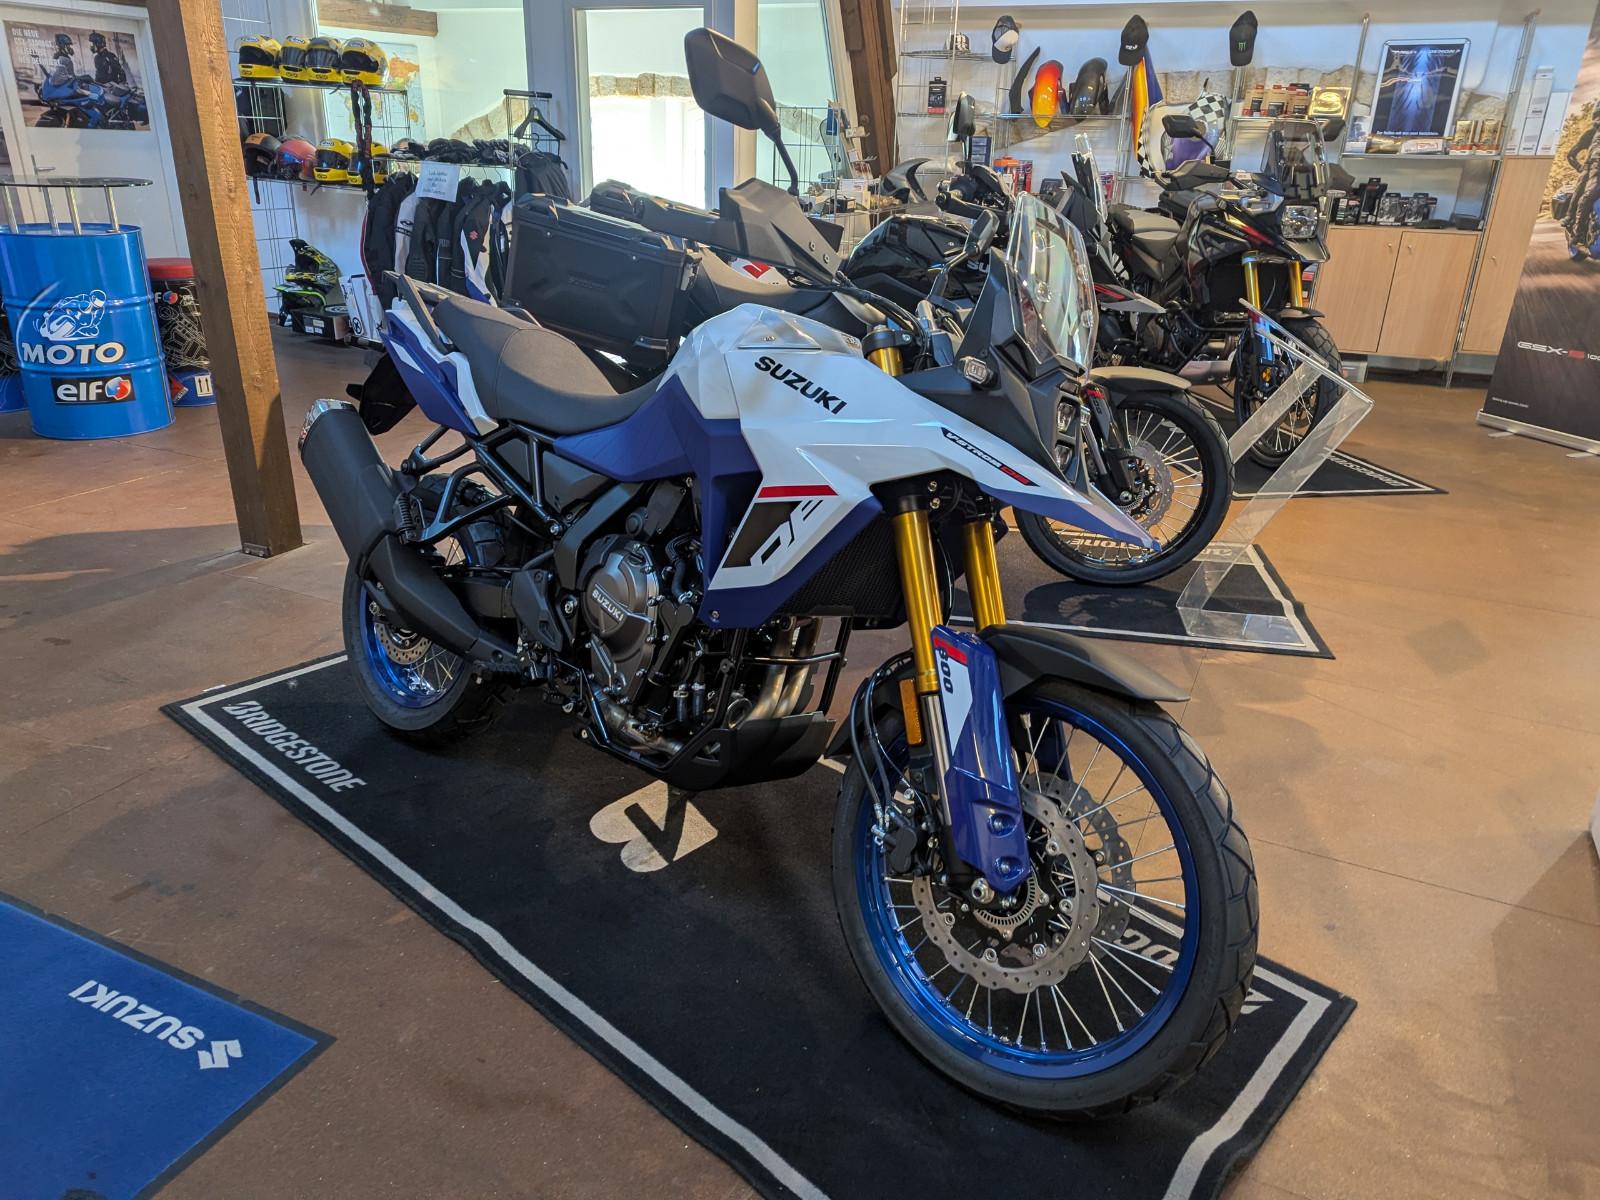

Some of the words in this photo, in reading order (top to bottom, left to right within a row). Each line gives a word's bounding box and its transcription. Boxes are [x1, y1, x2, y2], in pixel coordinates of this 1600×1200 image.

[22, 341, 125, 365] MOTO
[56, 381, 103, 401] elf
[754, 356, 847, 415] SUZUKI
[592, 589, 624, 622] SUZUKI
[221, 700, 367, 793] BRIDGESTONE
[68, 979, 205, 1050] SUZUKI
